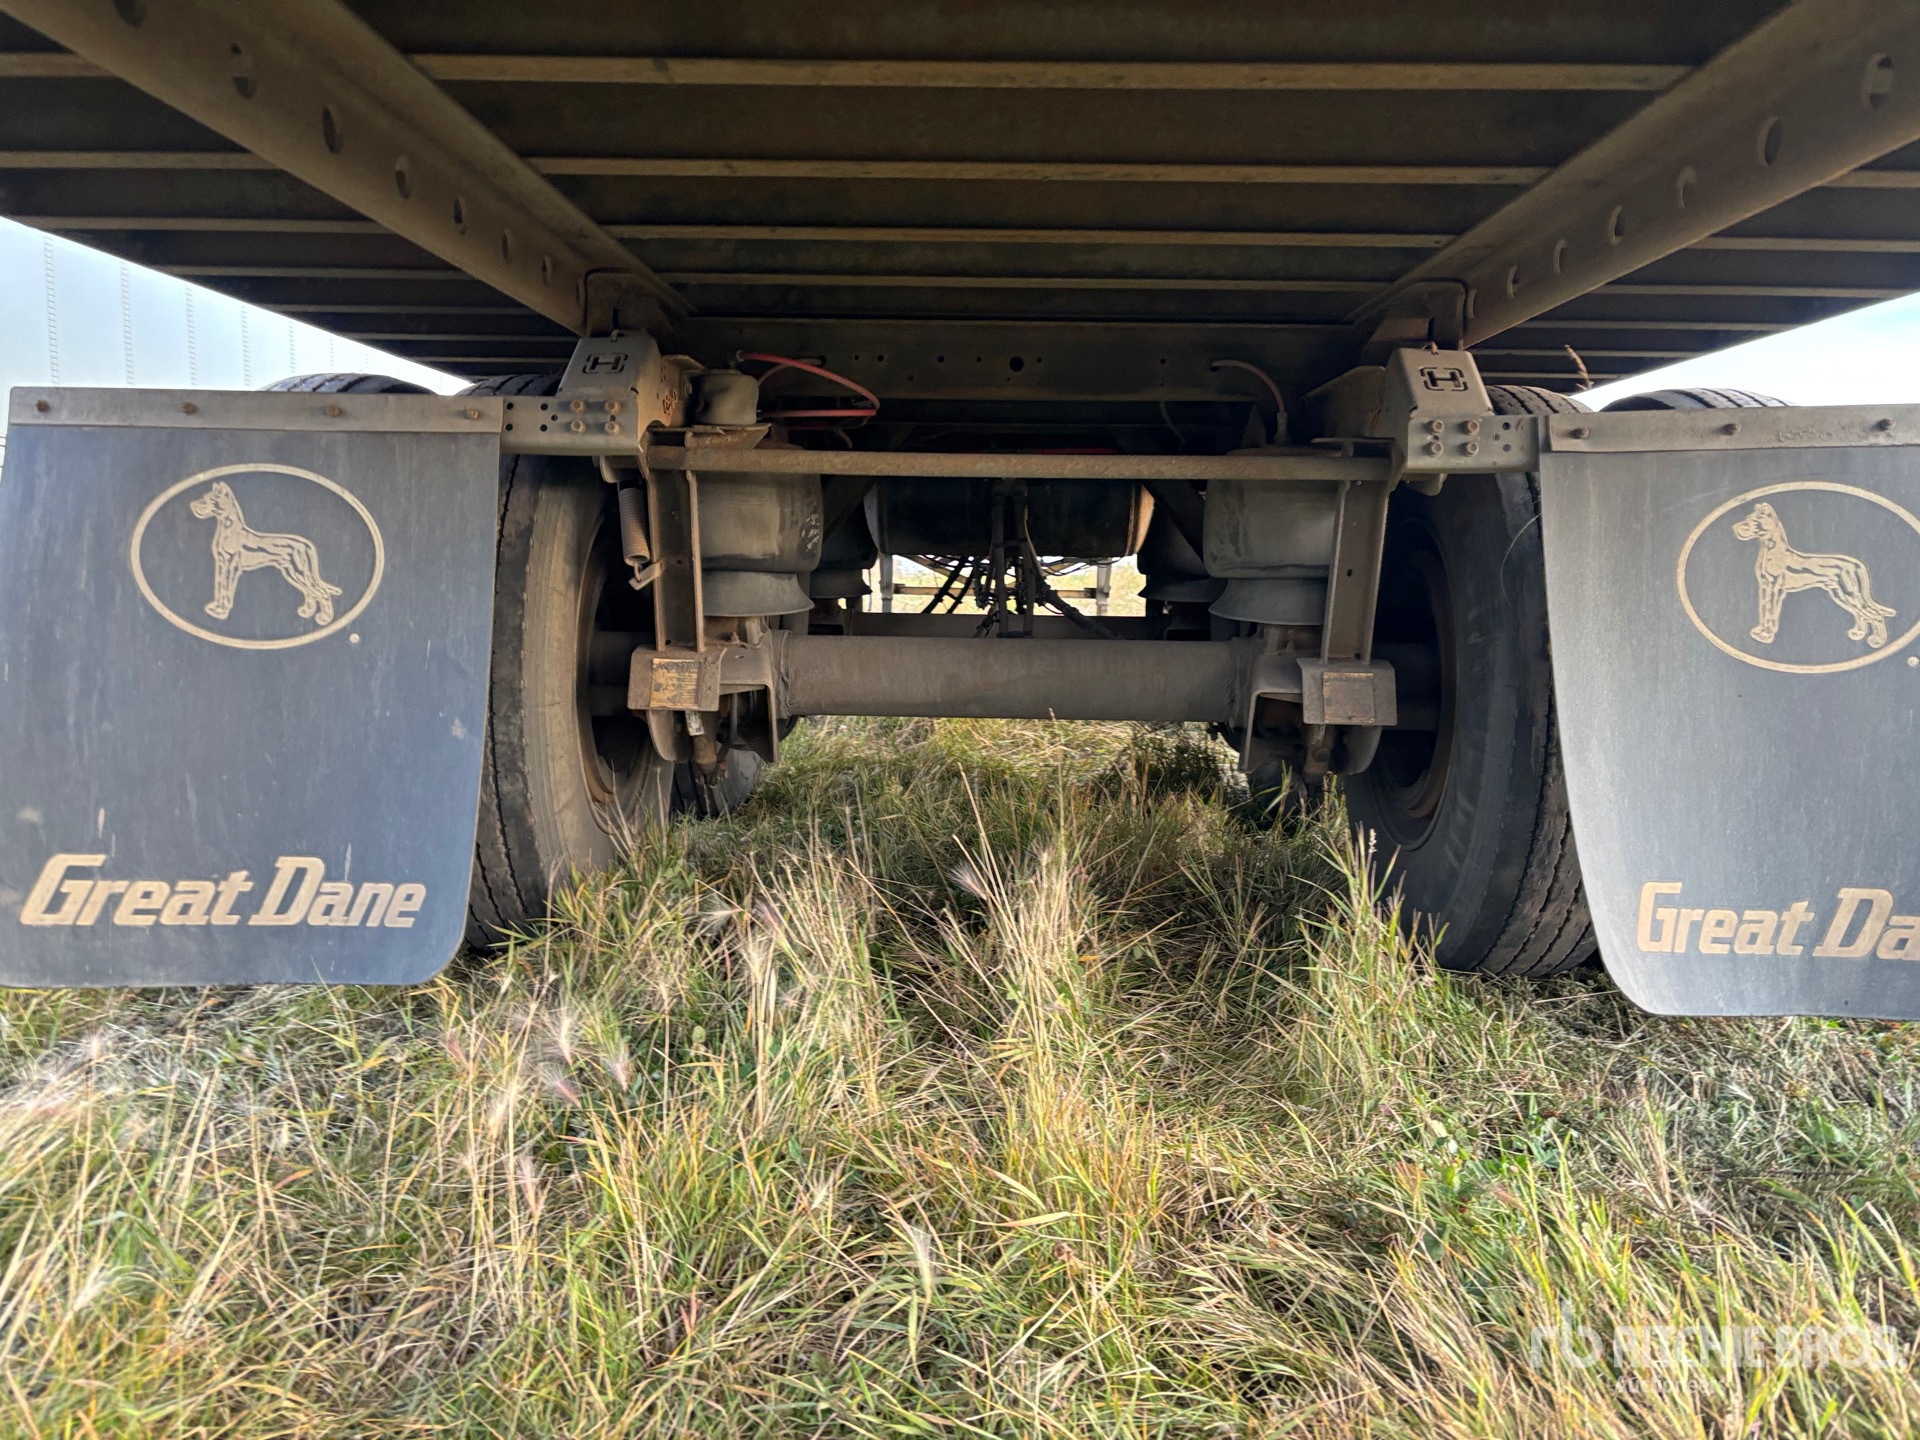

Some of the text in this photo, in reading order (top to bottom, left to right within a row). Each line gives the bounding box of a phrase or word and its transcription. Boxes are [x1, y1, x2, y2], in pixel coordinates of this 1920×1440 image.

[19, 853, 427, 928] Great Dane
[1637, 881, 1815, 956] Great
